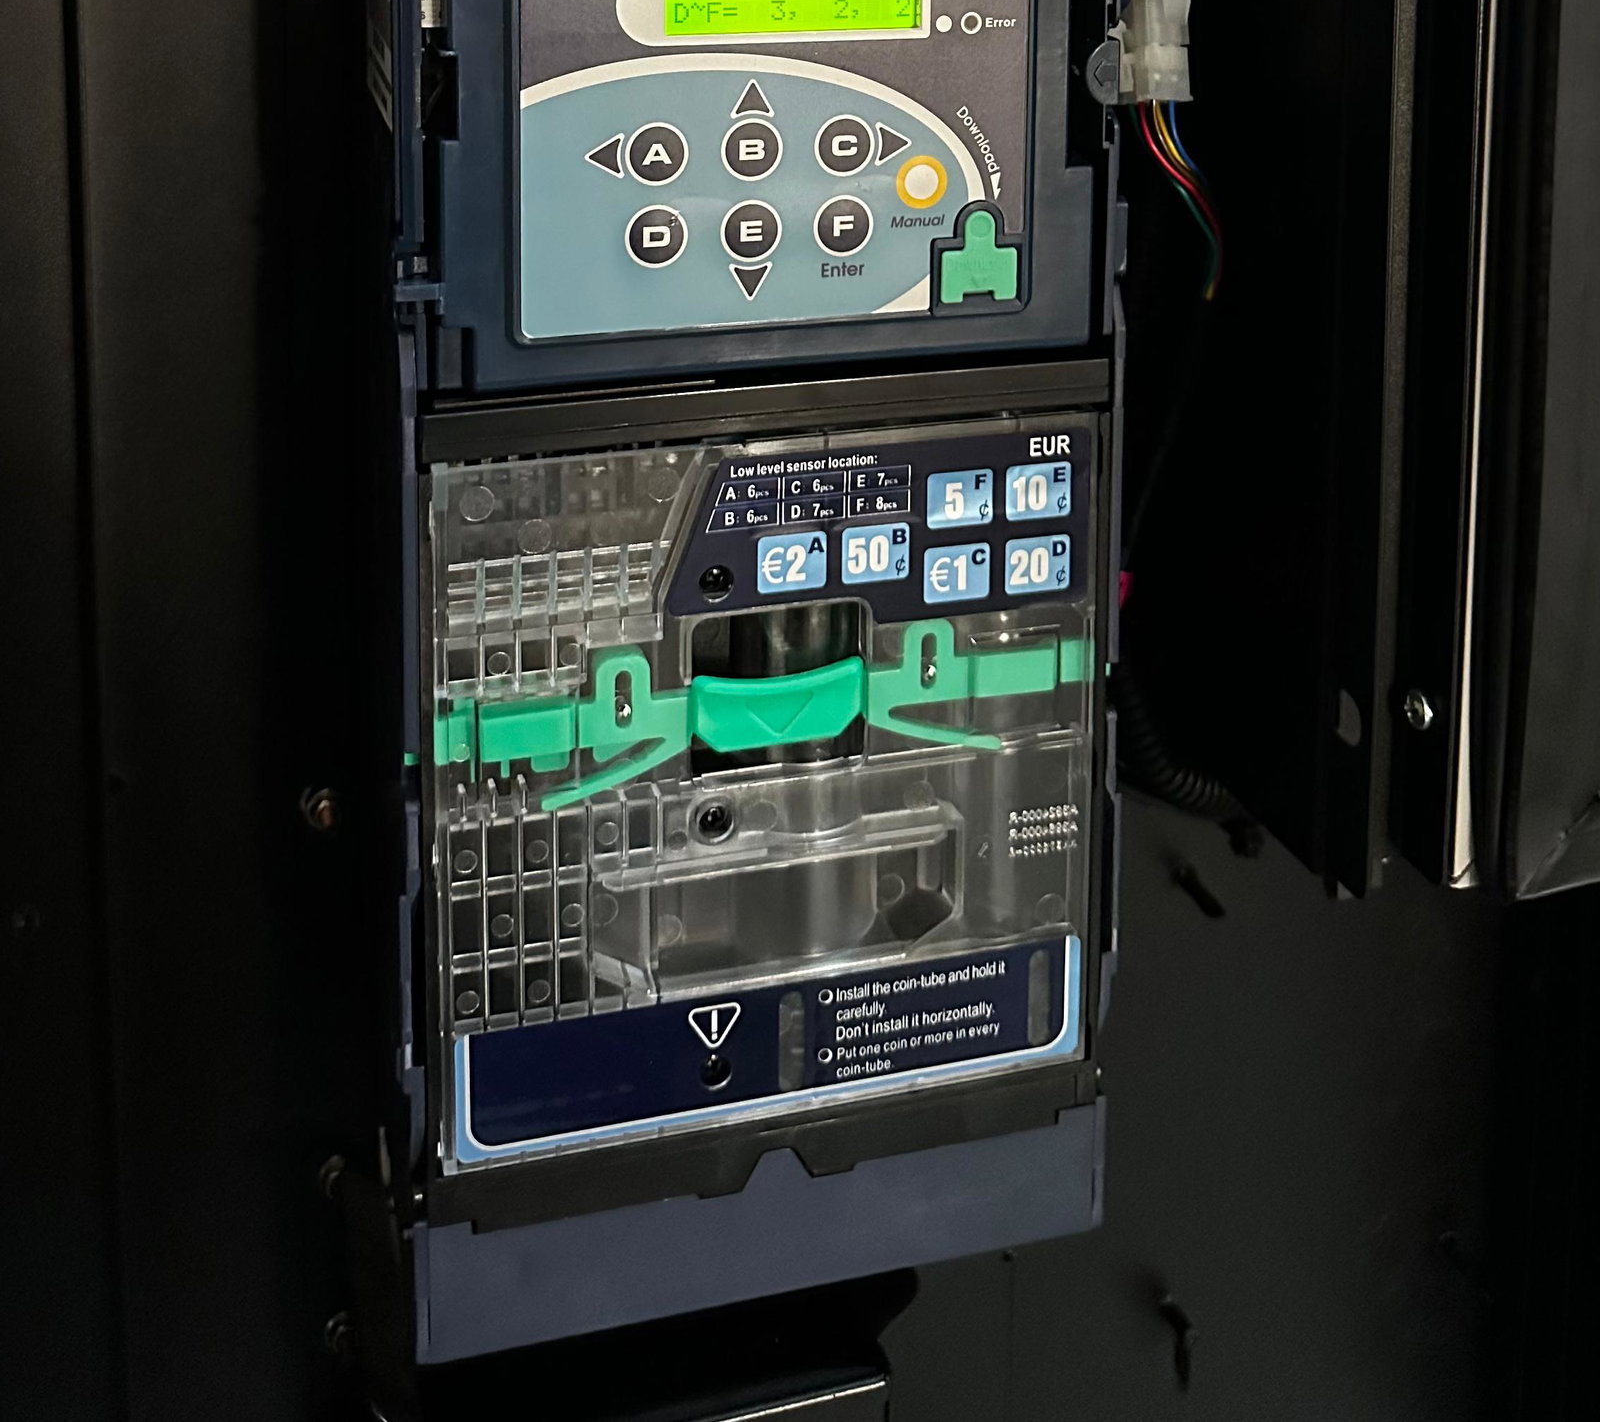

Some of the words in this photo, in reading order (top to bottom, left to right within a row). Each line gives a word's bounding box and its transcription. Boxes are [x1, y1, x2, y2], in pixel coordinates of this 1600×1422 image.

[985, 17, 1017, 28] Error
[738, 139, 766, 161] B
[830, 134, 859, 156] C
[956, 105, 1000, 174] Download
[642, 144, 674, 165] A
[739, 219, 763, 242] E
[833, 215, 855, 236] F
[891, 214, 945, 229] Manual
[642, 226, 672, 248] D
[820, 260, 865, 279] Enter
[1029, 435, 1071, 457] EUR
[730, 465, 755, 478] Low
[756, 460, 784, 475] level
[786, 460, 825, 472] sensor
[828, 454, 878, 468] location:
[1053, 466, 1066, 482] E
[974, 474, 987, 490] F
[807, 537, 825, 554] A
[892, 528, 907, 545] B
[971, 548, 986, 565] C
[1052, 540, 1067, 557] D
[761, 544, 807, 584] €2
[929, 554, 967, 592] €1
[836, 983, 869, 1002] Install
[872, 980, 891, 995] the
[893, 973, 946, 993] coin-tube
[948, 966, 970, 982] and
[972, 962, 996, 978] hold
[998, 960, 1006, 975] it
[836, 1001, 887, 1021] carefully.
[836, 1022, 869, 1042] Don't
[872, 1016, 909, 1034] install
[911, 1013, 920, 1027] it
[922, 1001, 995, 1025] horizontally.
[836, 1045, 857, 1060] Put
[859, 1042, 881, 1055] one
[883, 1038, 908, 1052] coin
[910, 1034, 922, 1047] or
[924, 1030, 953, 1045] more
[956, 1027, 966, 1039] in
[968, 1022, 1000, 1037] every
[836, 1058, 895, 1078] coin-tube.
